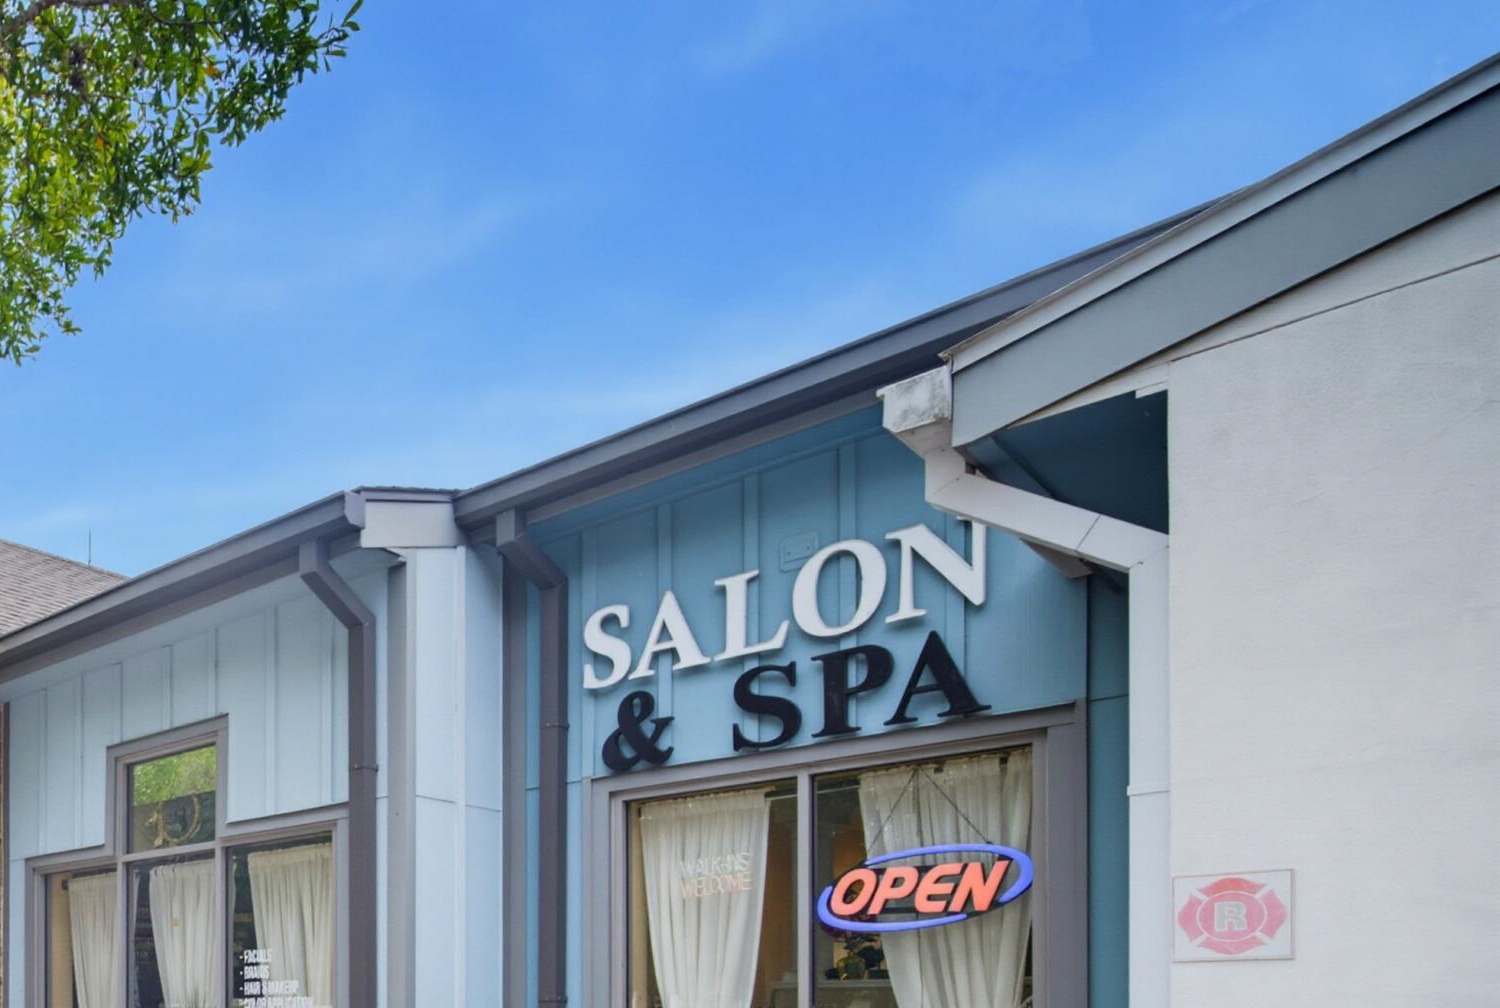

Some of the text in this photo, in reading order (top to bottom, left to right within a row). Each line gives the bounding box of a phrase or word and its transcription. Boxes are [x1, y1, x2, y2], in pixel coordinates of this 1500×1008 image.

[583, 515, 988, 690] SALON
[601, 630, 993, 772] & SPA
[680, 851, 750, 880] WALK-INS
[681, 871, 753, 898] WELCOME
[830, 861, 1010, 916] OPEN
[1213, 900, 1248, 932] R
[244, 981, 260, 996] HAIR
